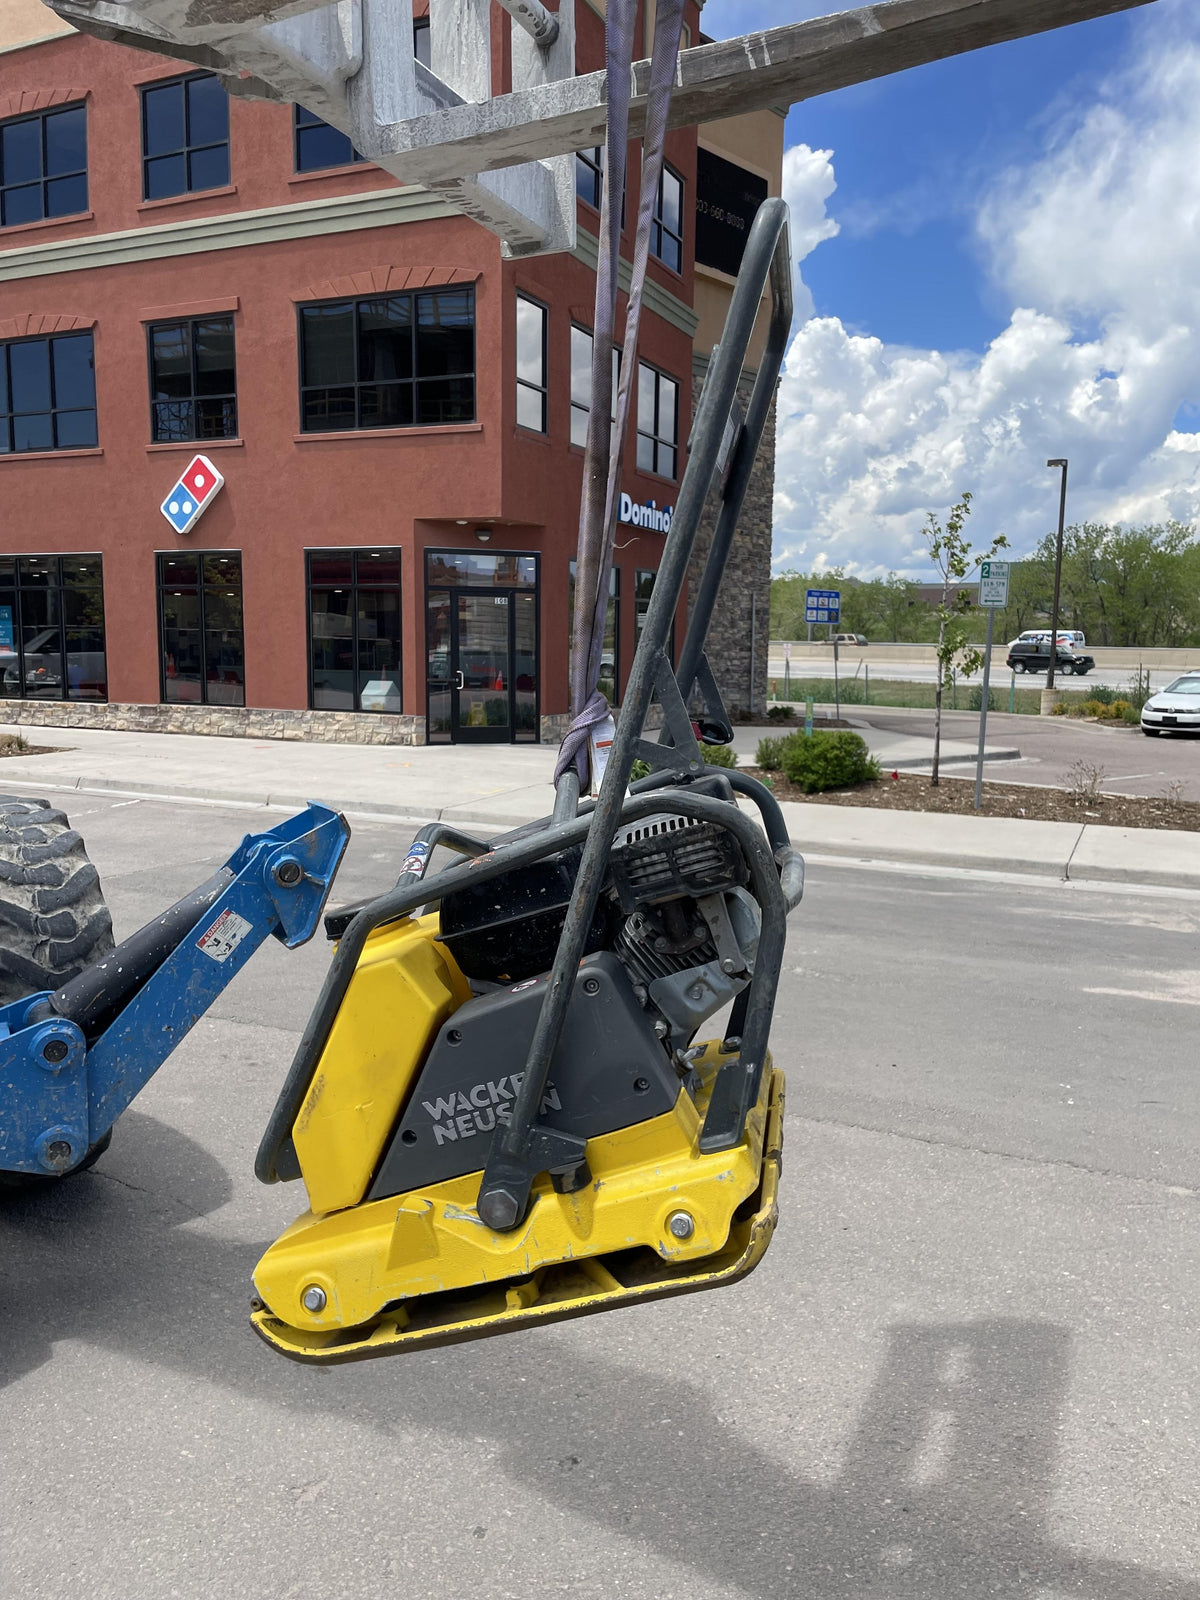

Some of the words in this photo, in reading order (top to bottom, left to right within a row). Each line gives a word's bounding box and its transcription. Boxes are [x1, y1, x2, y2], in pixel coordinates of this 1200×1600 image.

[619, 492, 673, 533] Domino'
[982, 564, 989, 577] 2
[208, 914, 227, 936] DANGER
[421, 1071, 555, 1121] WACKE
[432, 1088, 562, 1145] NEUSN
